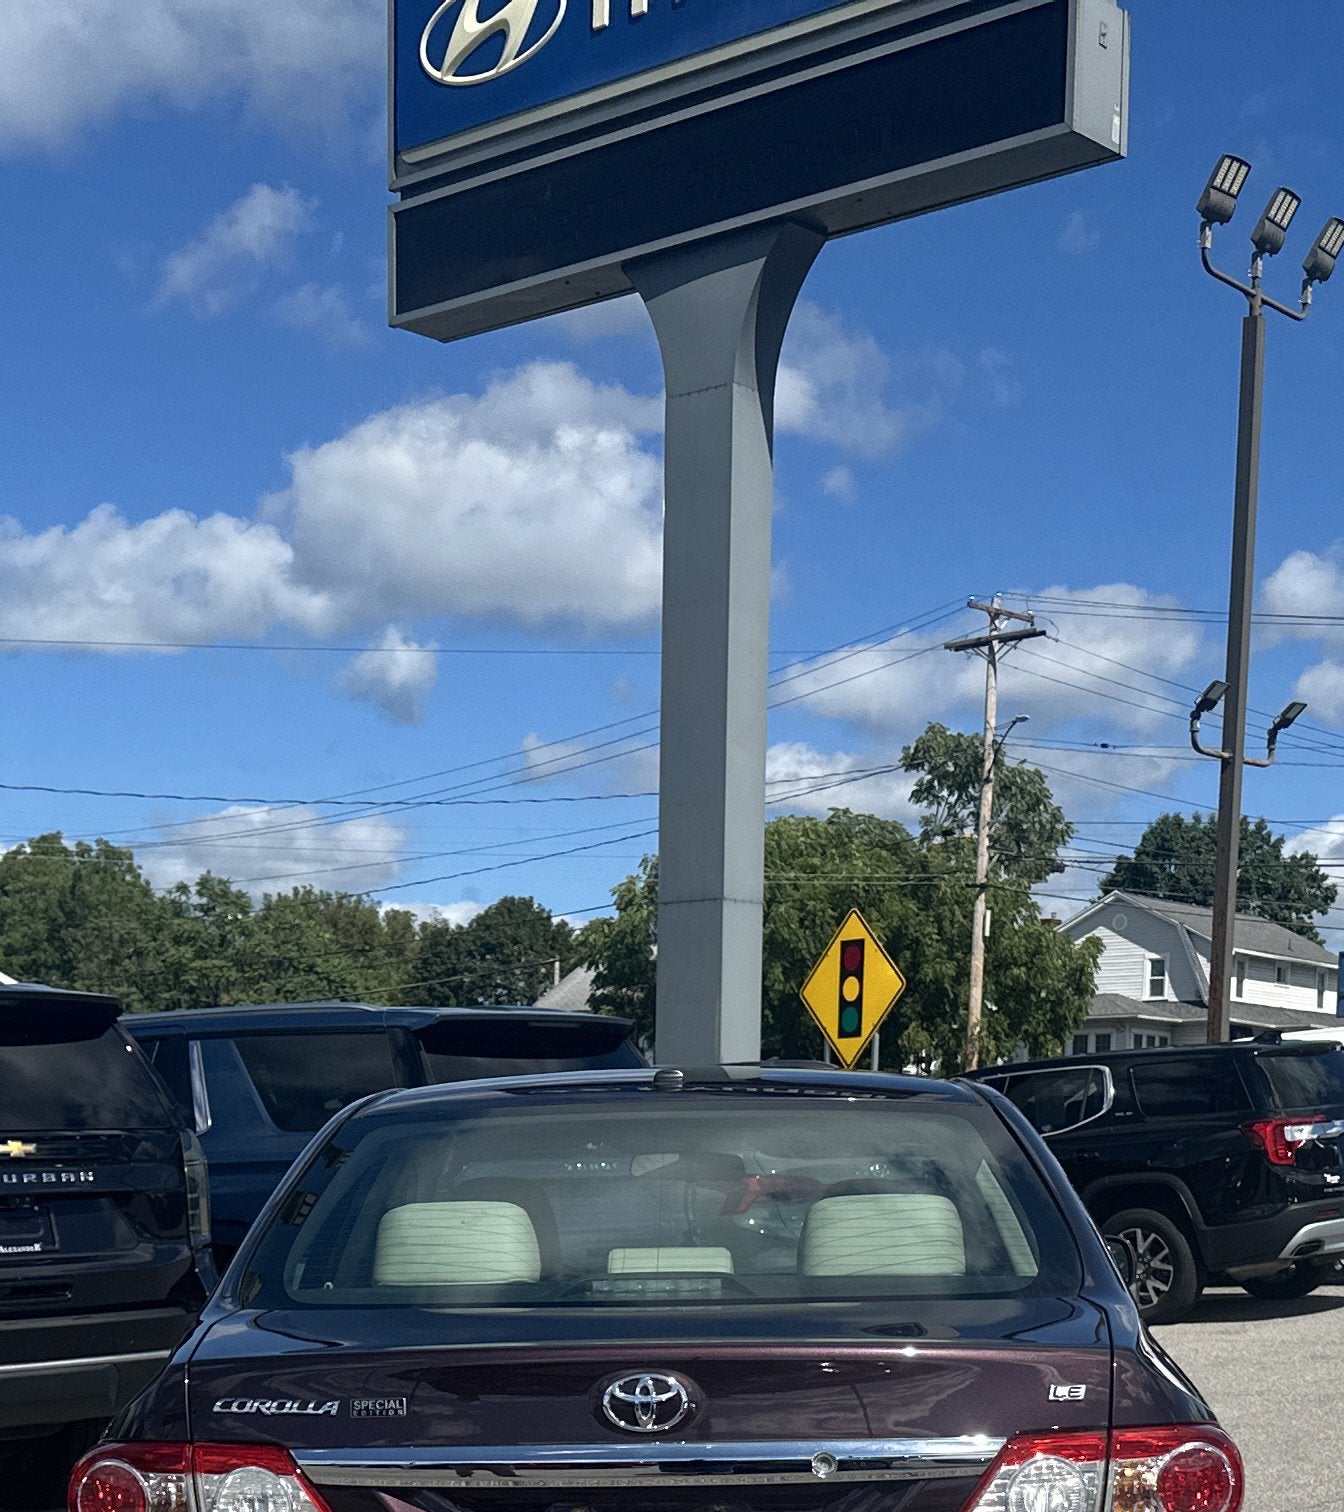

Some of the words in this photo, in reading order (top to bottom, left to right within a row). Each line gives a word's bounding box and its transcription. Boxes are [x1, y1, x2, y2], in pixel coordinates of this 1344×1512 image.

[1048, 1384, 1086, 1401] LE
[212, 1398, 341, 1415] COROLLA
[353, 1399, 403, 1410] SPECIAL
